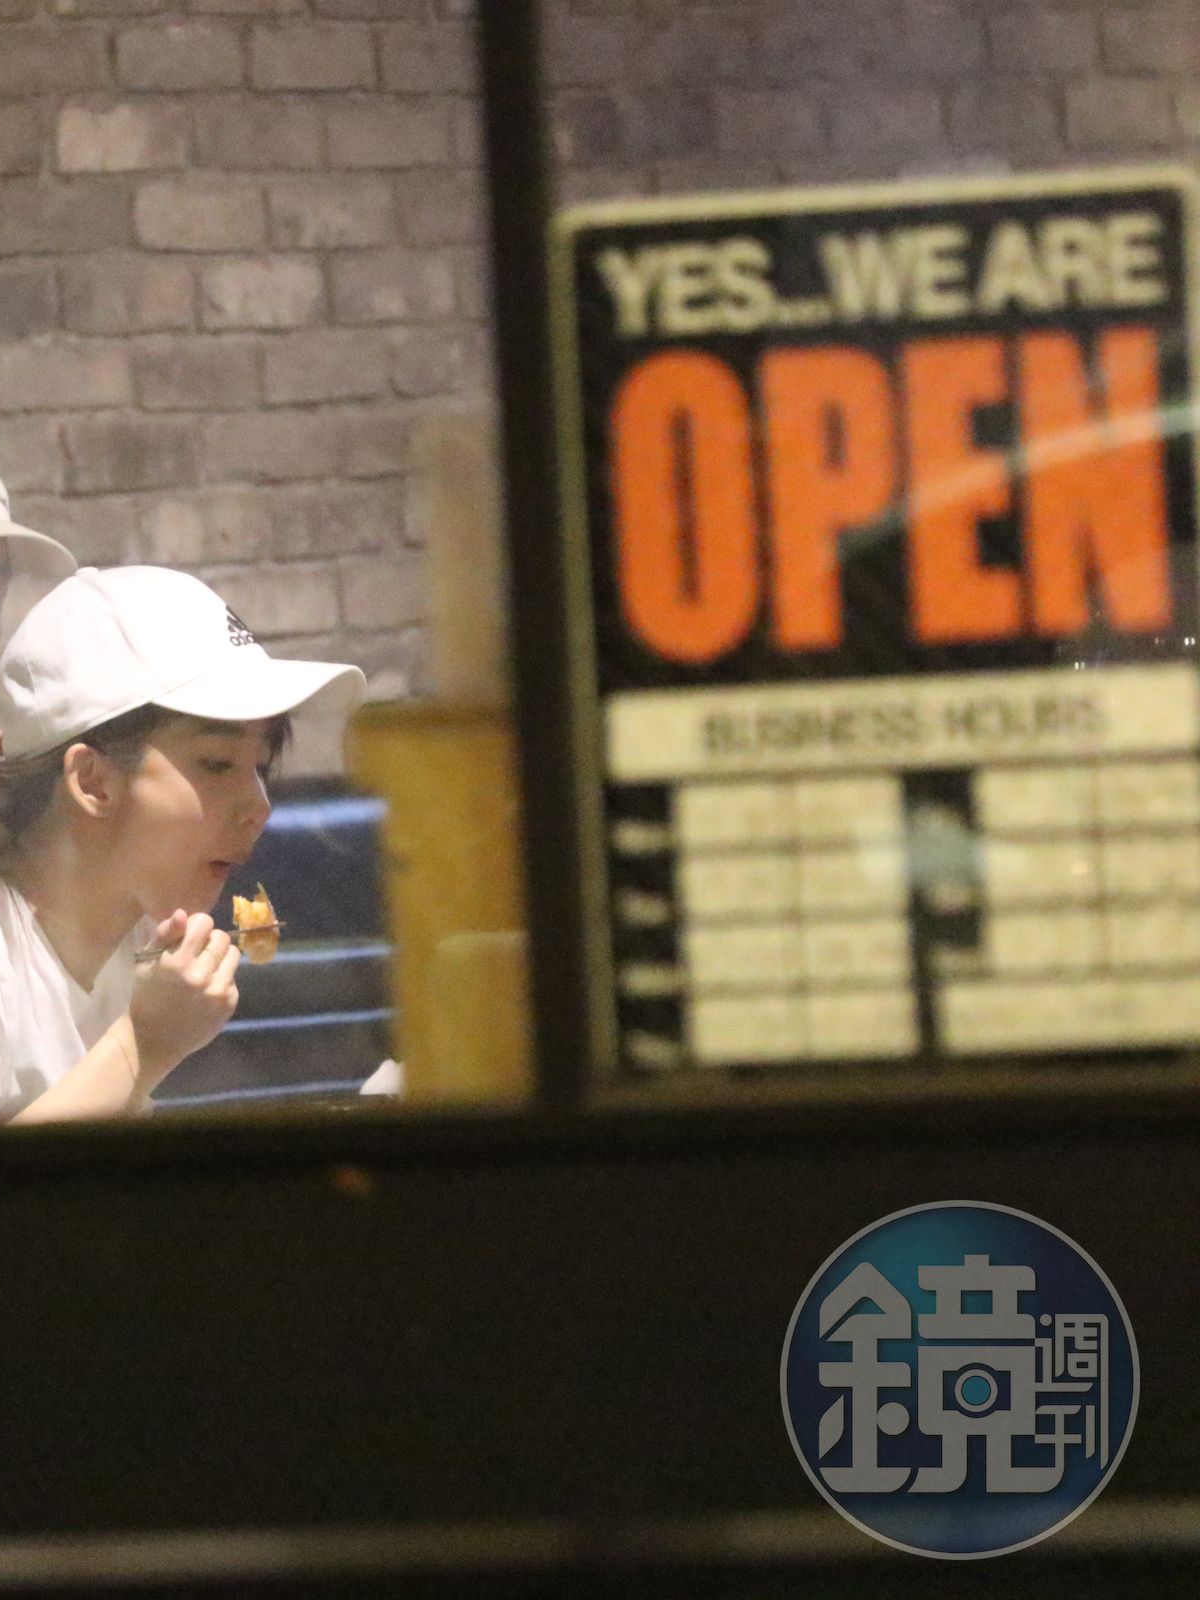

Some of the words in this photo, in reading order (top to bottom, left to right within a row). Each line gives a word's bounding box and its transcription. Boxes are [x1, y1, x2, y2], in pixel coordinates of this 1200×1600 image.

[613, 327, 1170, 664] OPEN
[704, 703, 923, 755] BUSINESS
[938, 691, 1106, 742] HOURS
